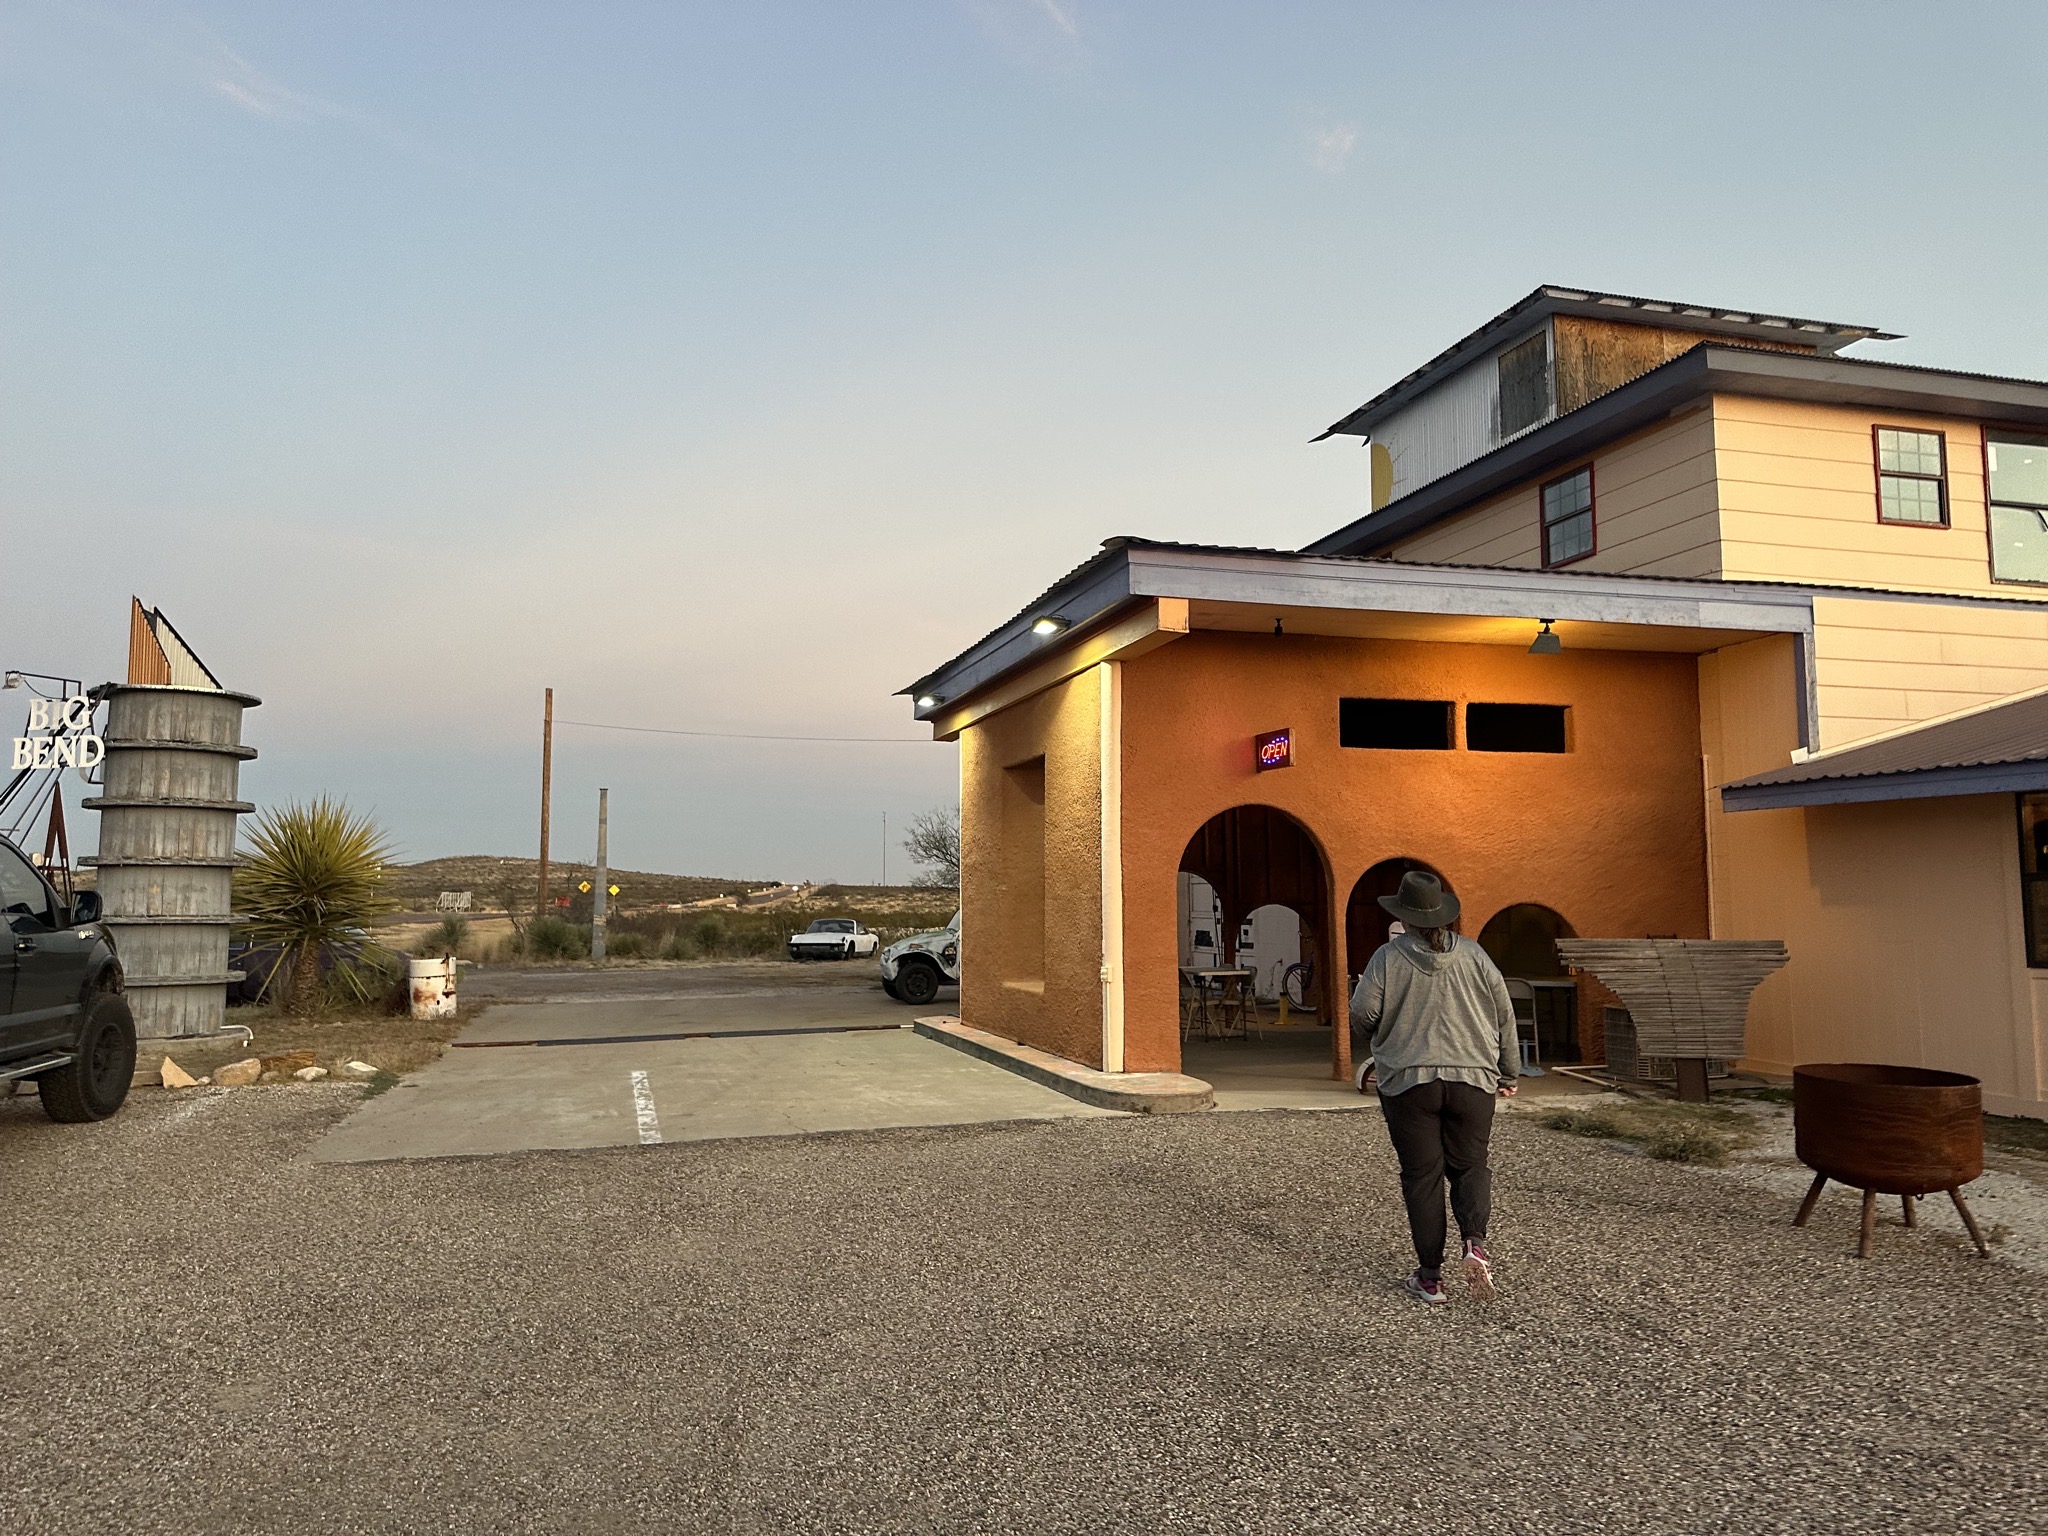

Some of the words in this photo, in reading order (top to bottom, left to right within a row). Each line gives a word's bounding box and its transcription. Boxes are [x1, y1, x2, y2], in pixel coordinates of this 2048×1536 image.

[28, 696, 92, 731] BIG
[11, 735, 105, 769] BEND
[1261, 742, 1288, 759] OPEN
